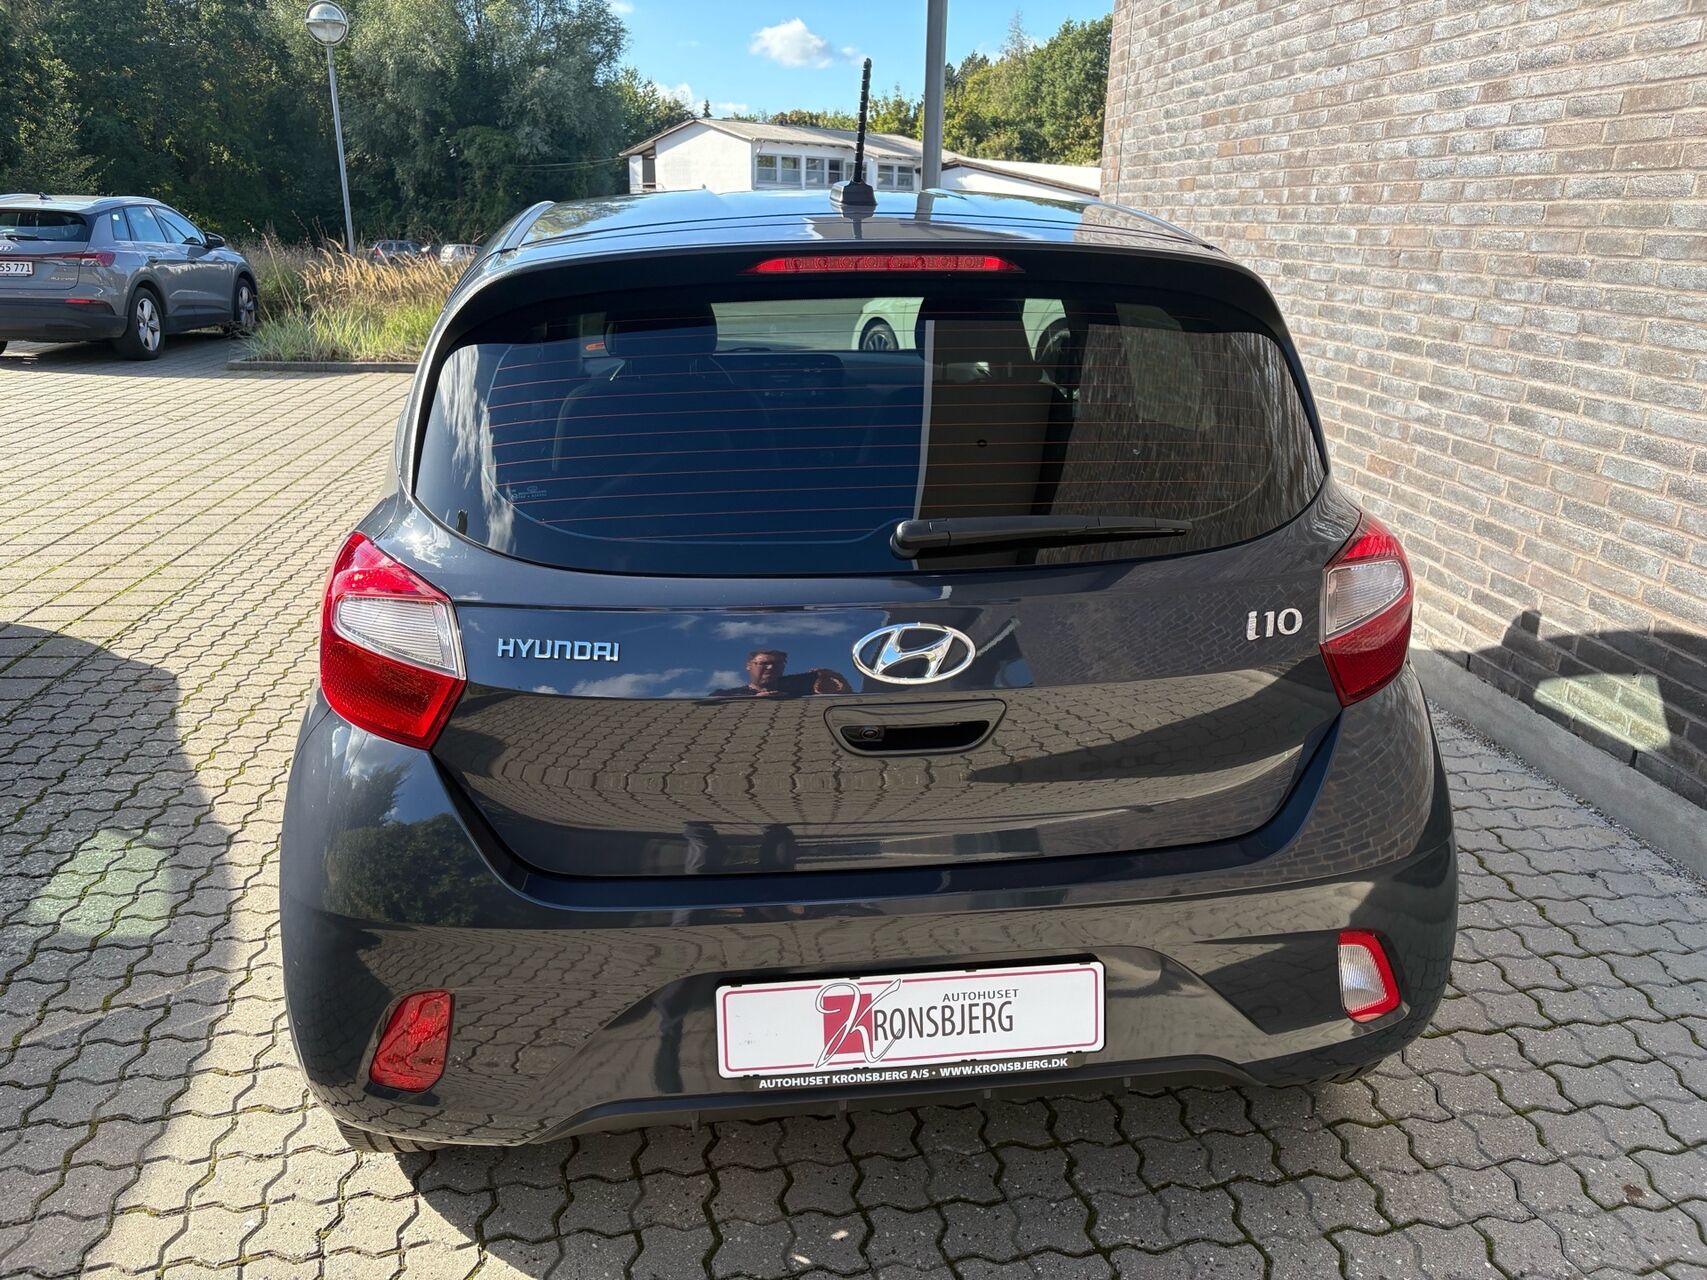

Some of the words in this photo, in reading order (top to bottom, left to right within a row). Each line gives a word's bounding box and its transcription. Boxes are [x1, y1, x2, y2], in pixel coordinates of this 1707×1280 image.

[14, 263, 31, 273] 771
[497, 638, 620, 662] HYUNDAI
[942, 988, 1020, 1003] AUTOHUSET
[758, 1075, 831, 1089] AUTOHUSET
[832, 1070, 909, 1085] KRONSBJERG
[910, 1068, 930, 1080] A/S
[939, 1057, 1069, 1077] WWW.KRONSBJERG.DK
